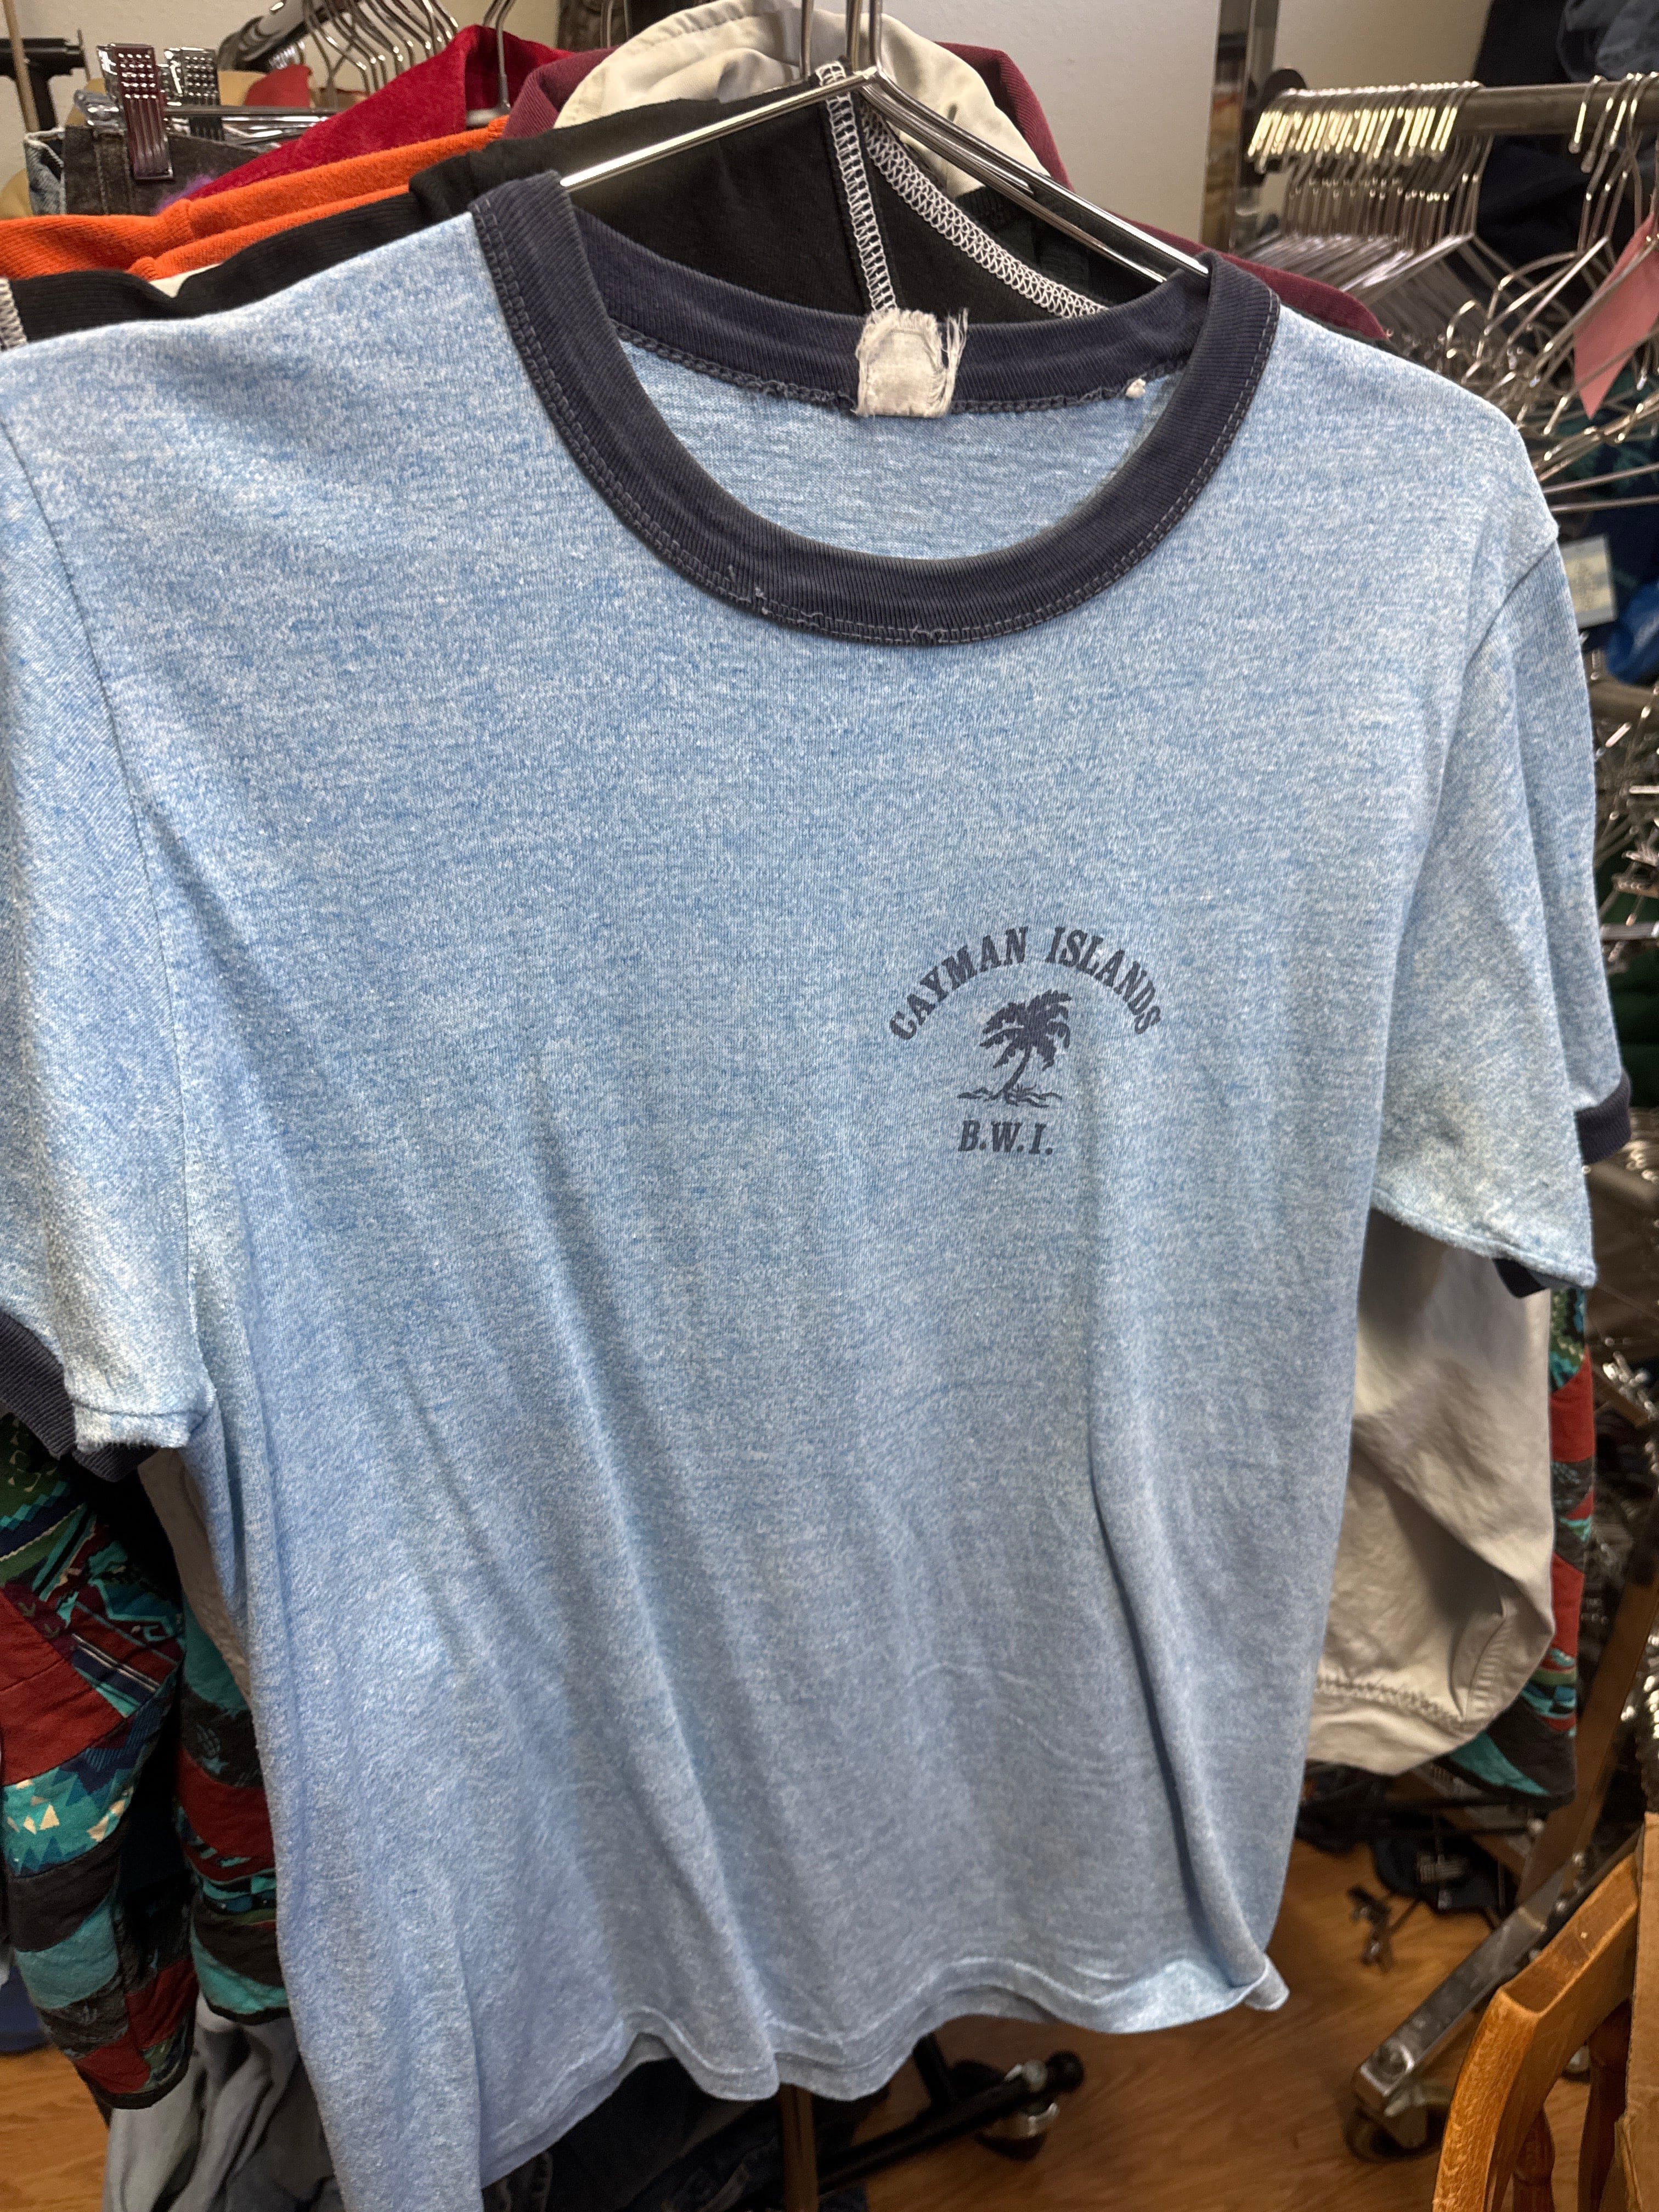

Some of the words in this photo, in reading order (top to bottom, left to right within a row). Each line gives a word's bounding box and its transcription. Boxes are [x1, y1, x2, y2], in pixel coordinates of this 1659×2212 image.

[889, 926, 1029, 1041] CAYMAN
[1045, 926, 1161, 1035] ISLANDS
[957, 1119, 1053, 1155] B.W.I.
